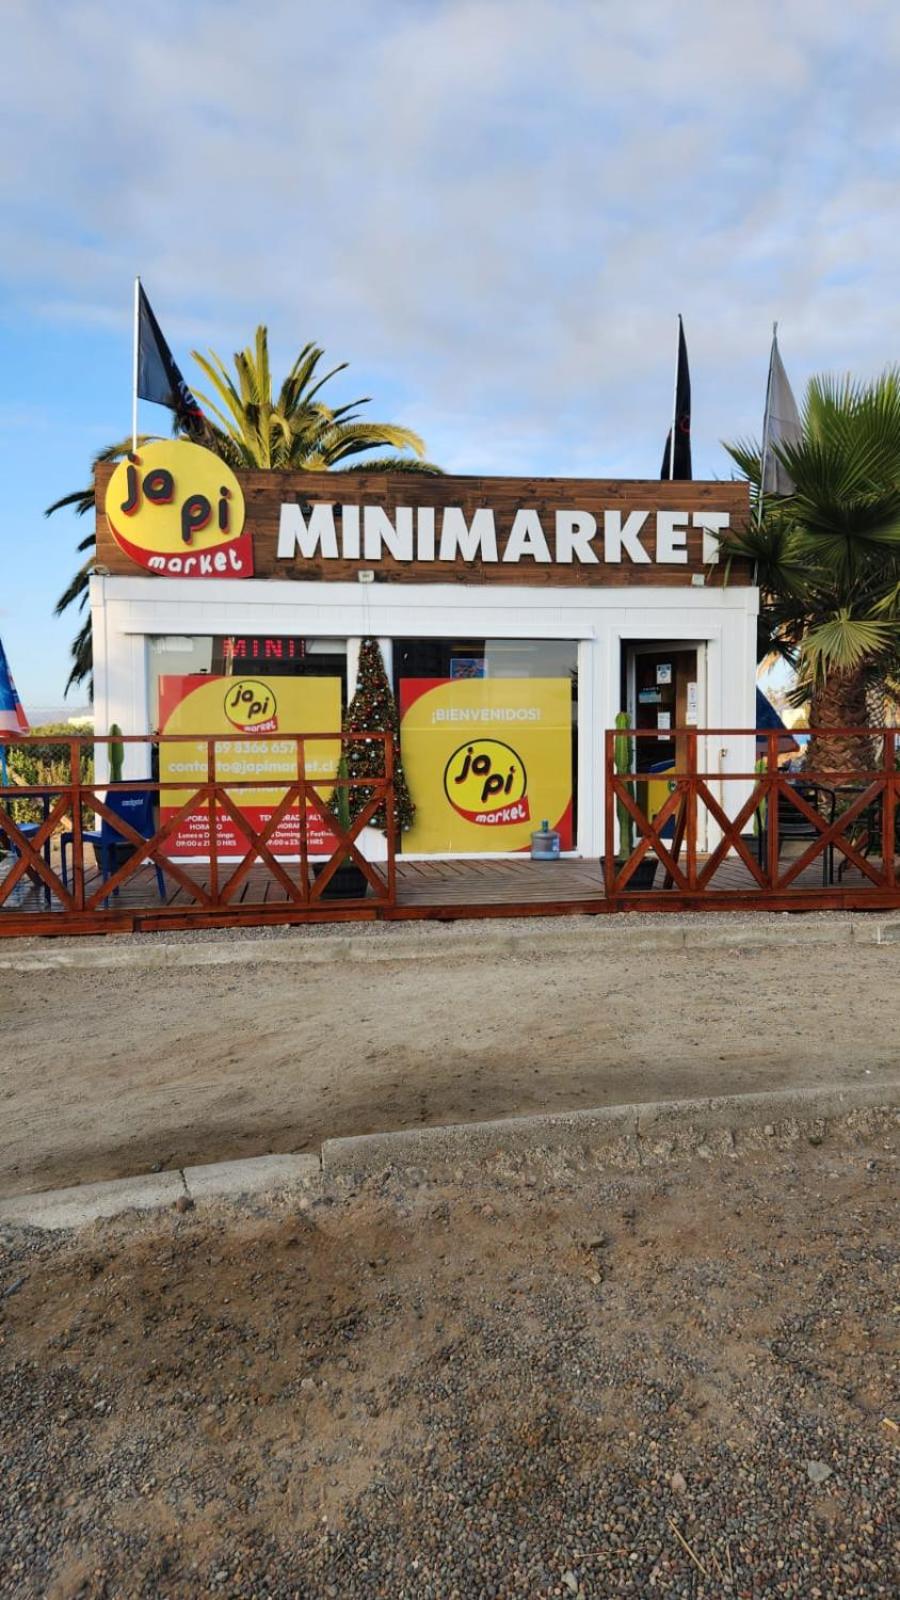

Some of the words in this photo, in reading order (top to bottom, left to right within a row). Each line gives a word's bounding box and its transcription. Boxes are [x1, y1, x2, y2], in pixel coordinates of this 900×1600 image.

[277, 502, 730, 564] MINIMARKET
[147, 548, 243, 575] market
[431, 707, 541, 724] ¡BIENVENIDOS!
[243, 719, 277, 731] market
[168, 760, 333, 775] contato@japimaret.cl
[474, 804, 527, 823] market
